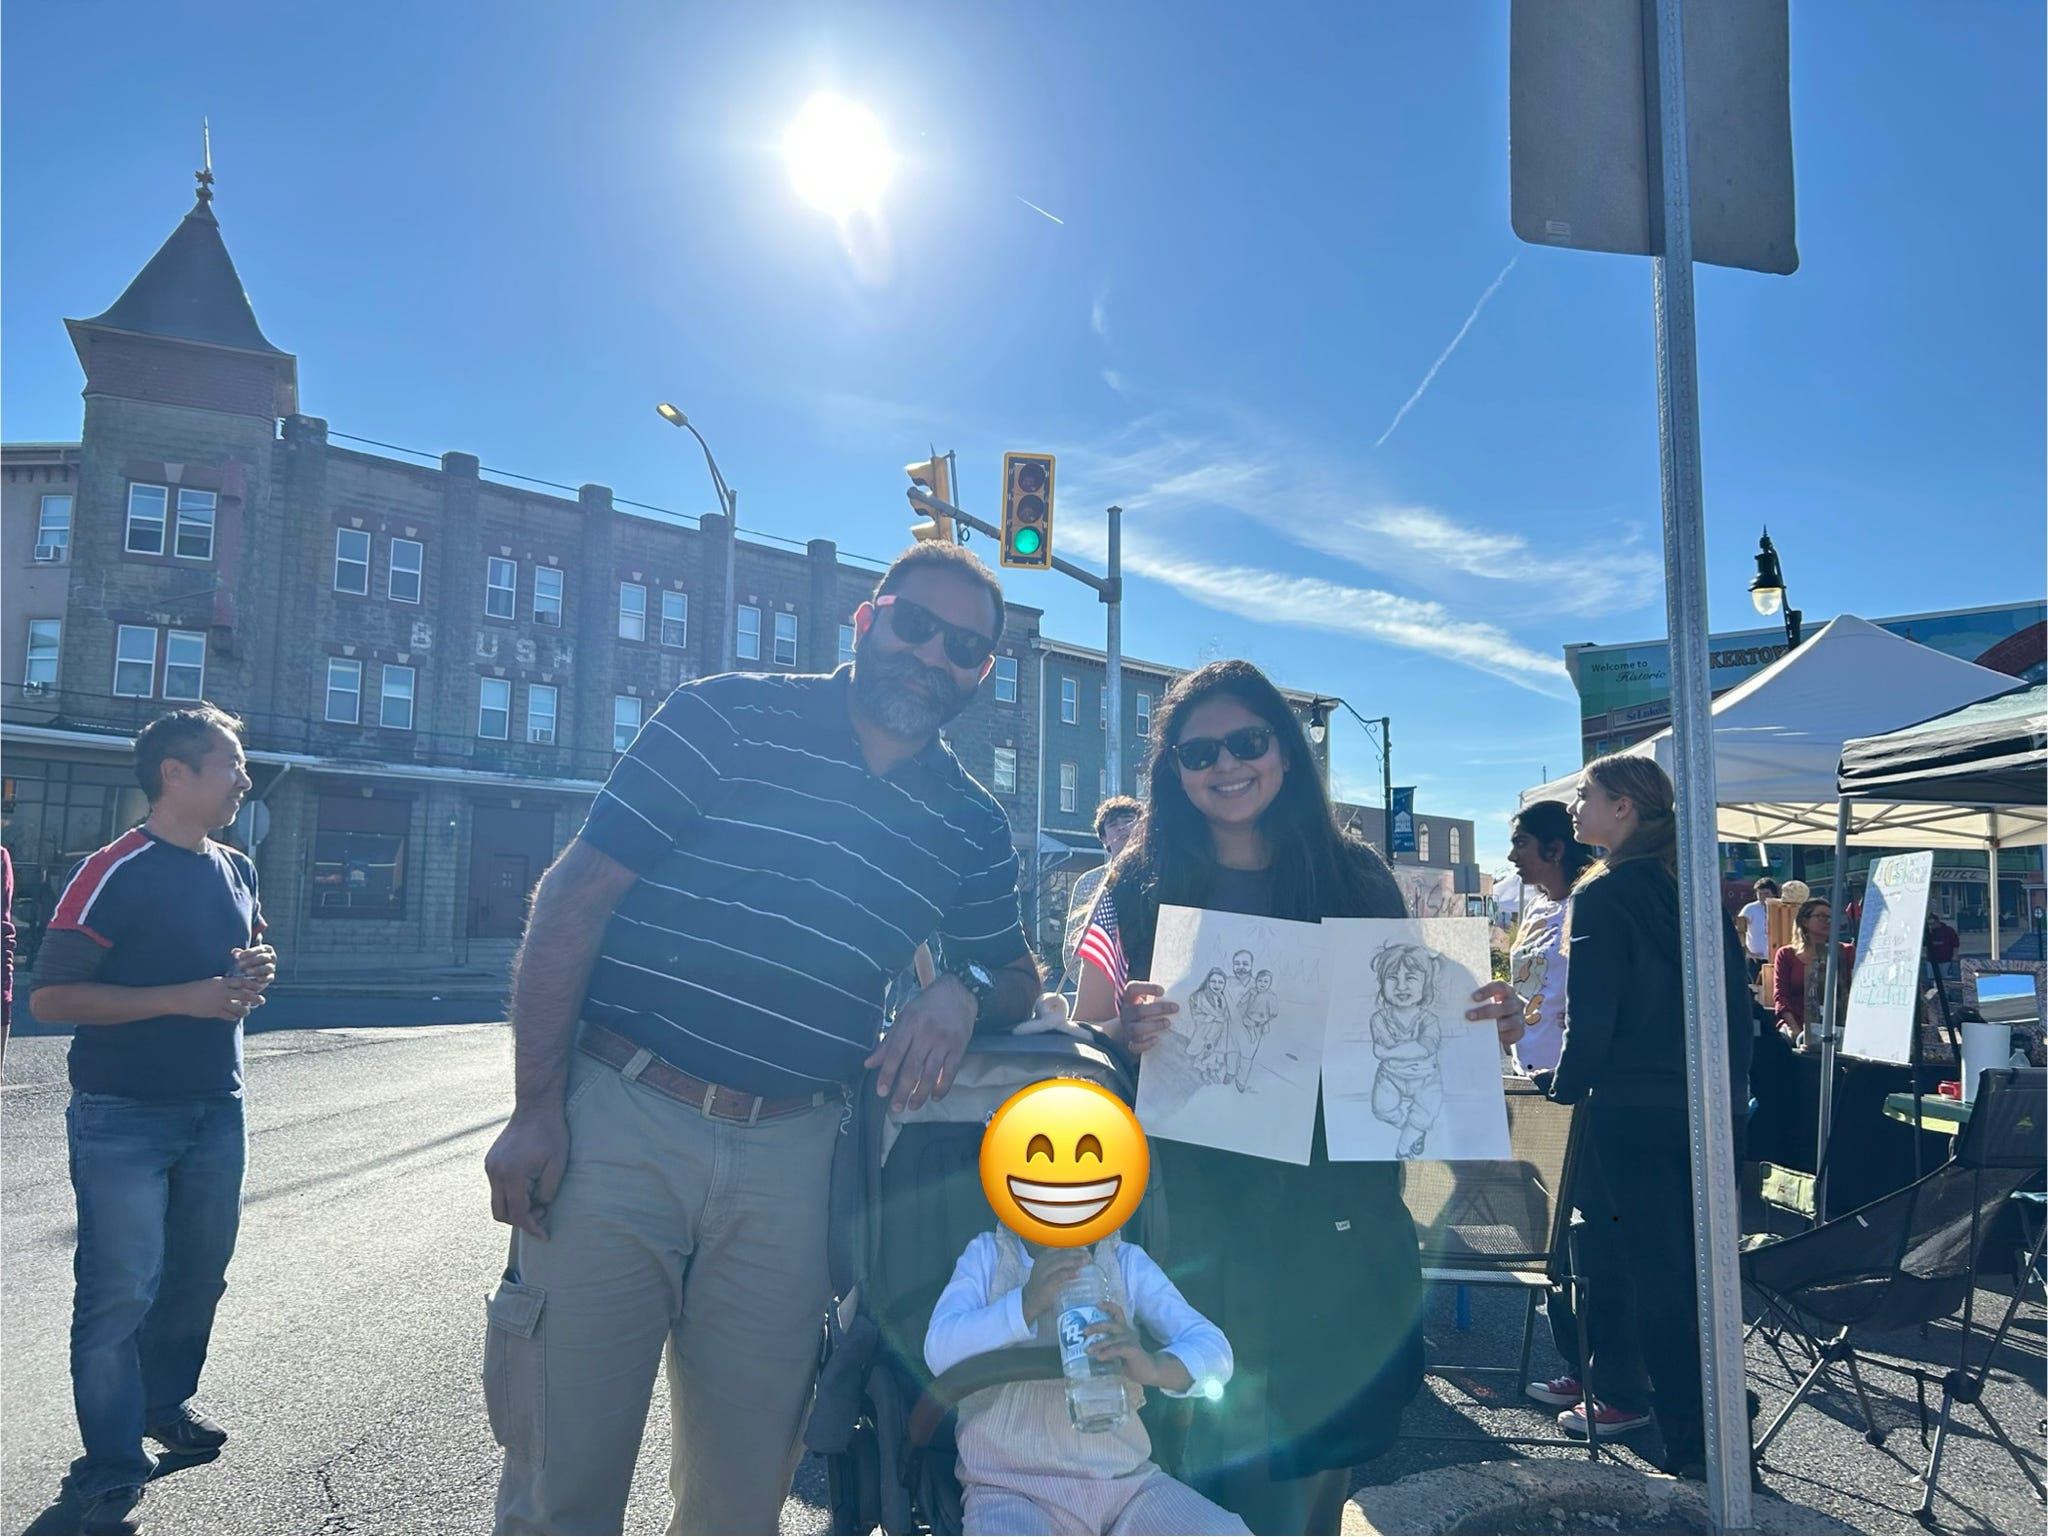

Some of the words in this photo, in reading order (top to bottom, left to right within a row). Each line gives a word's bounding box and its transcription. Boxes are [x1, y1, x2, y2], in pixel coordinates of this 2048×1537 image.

[1591, 661, 1635, 673] Welcome
[1637, 660, 1648, 668] to
[1615, 670, 1667, 682] Historic
[1932, 868, 1977, 880] HOTEL
